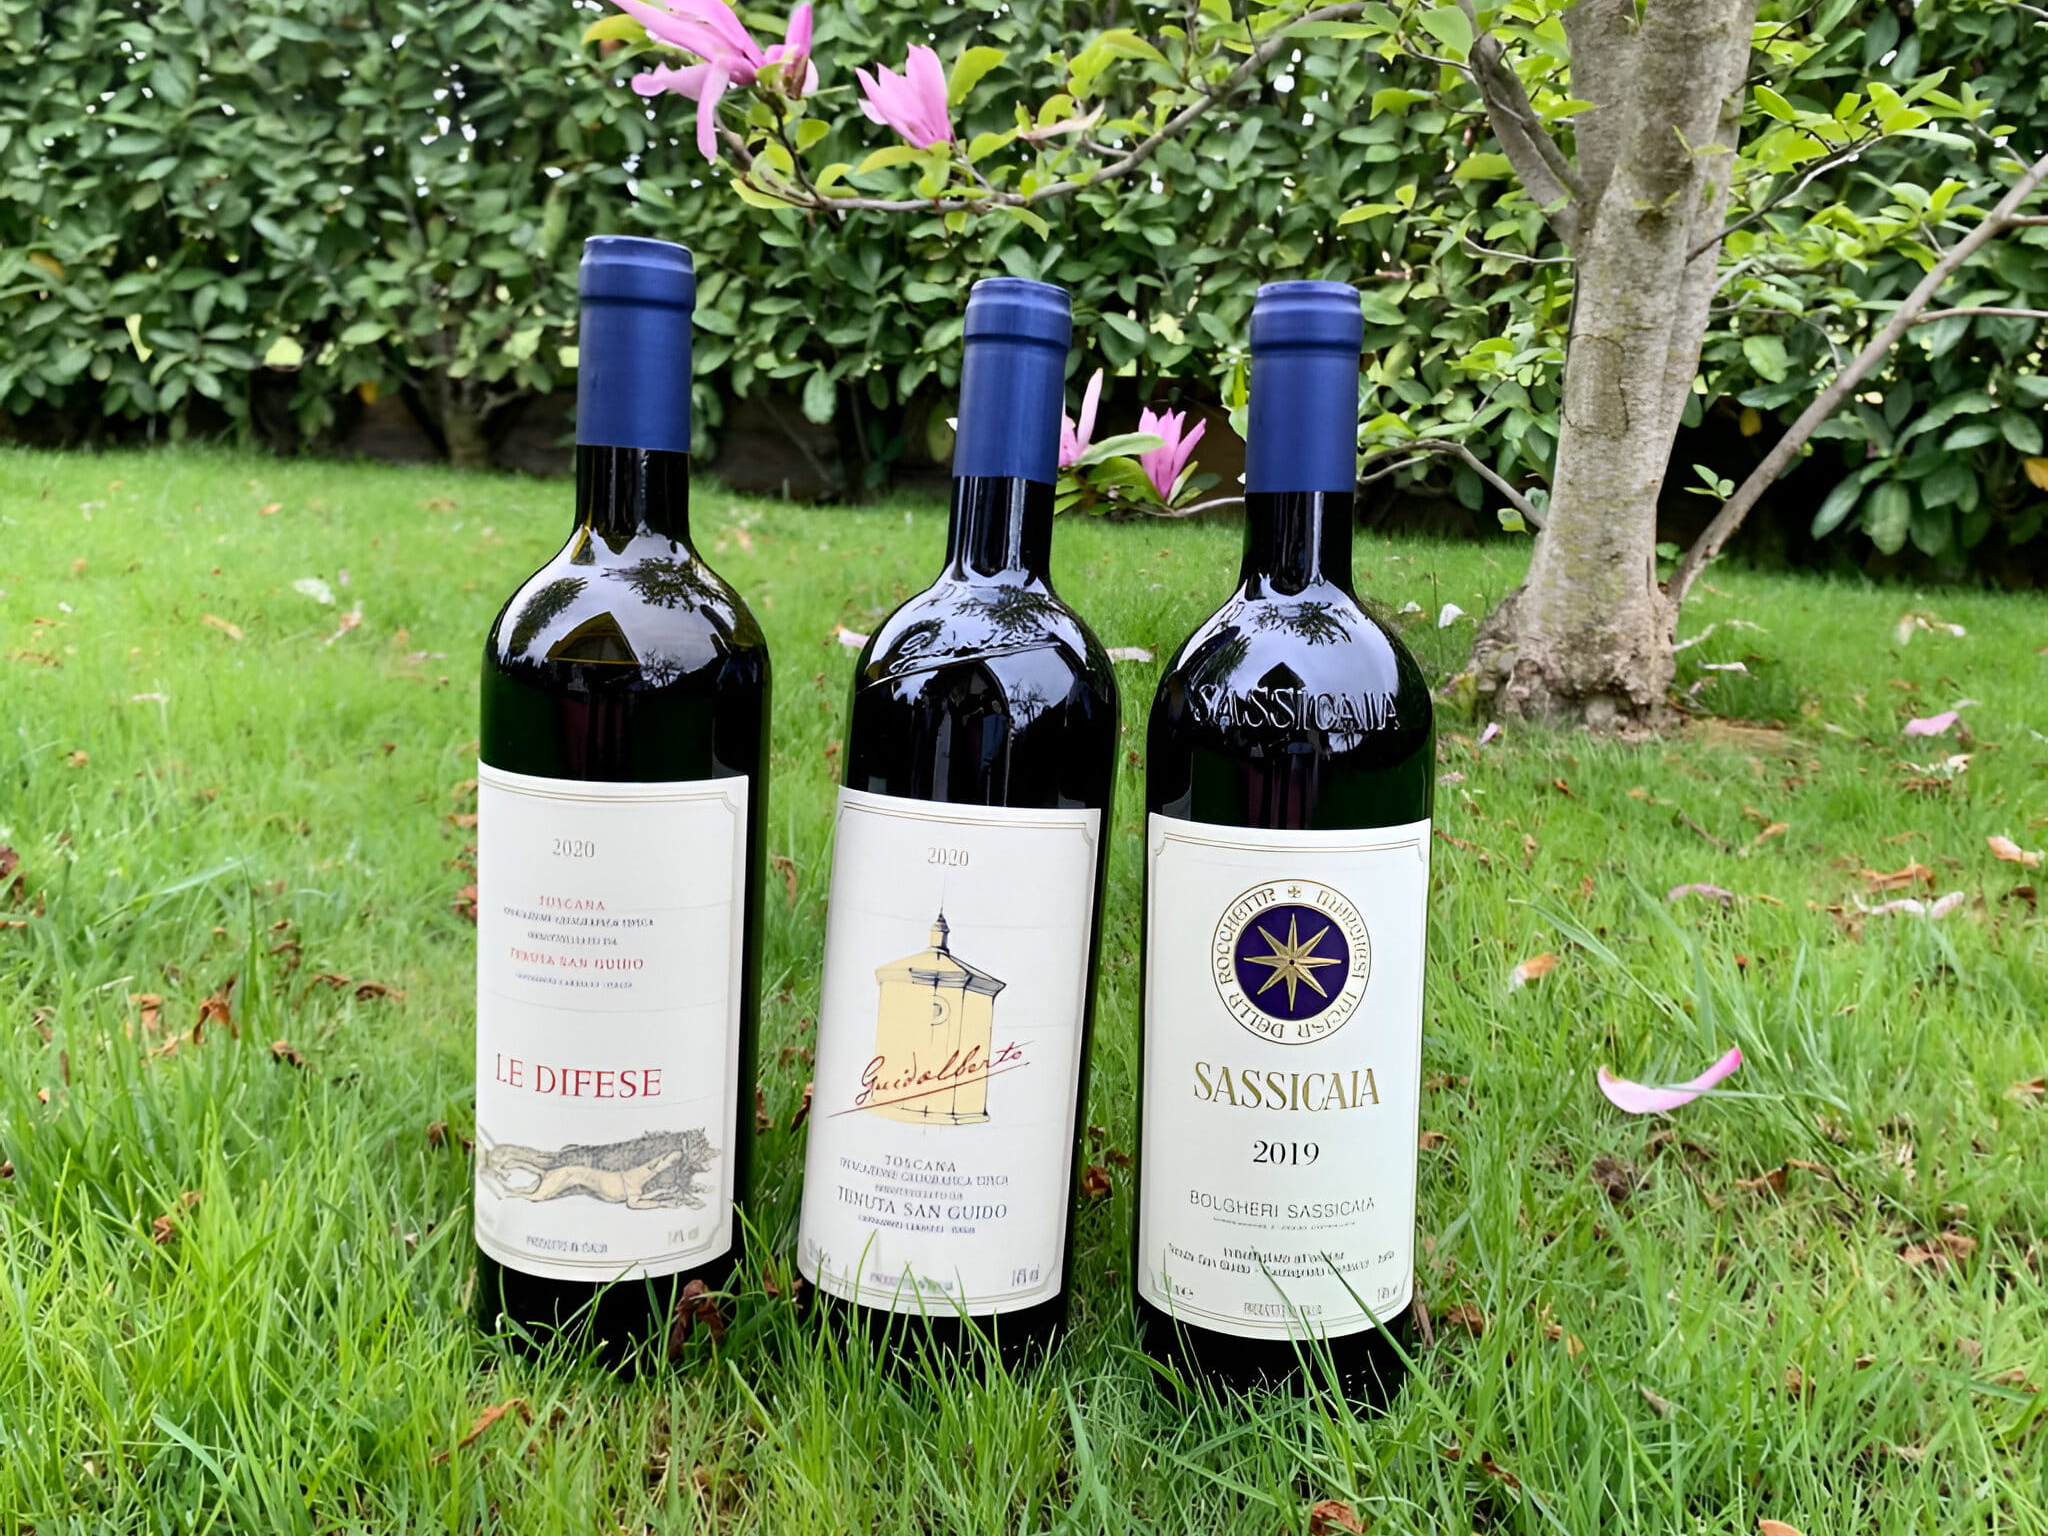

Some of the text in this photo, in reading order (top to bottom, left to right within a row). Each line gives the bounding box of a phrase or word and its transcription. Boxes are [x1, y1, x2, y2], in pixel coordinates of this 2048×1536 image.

[1190, 684, 1401, 731] SASSICAIA
[552, 839, 595, 858] 2020
[927, 847, 969, 866] 2020
[496, 1053, 662, 1099] LE DIFESE
[855, 1040, 1034, 1106] Guidalberto
[1193, 1061, 1380, 1112] SASSICAIA
[885, 1154, 957, 1173] TOSCANA
[1253, 1140, 1320, 1166] 2019
[837, 1185, 895, 1214] TENUTA
[903, 1202, 941, 1219] SAN
[947, 1203, 1007, 1220] GUIDO
[1190, 1190, 1376, 1219] BOLGHERI SASSICAIA
